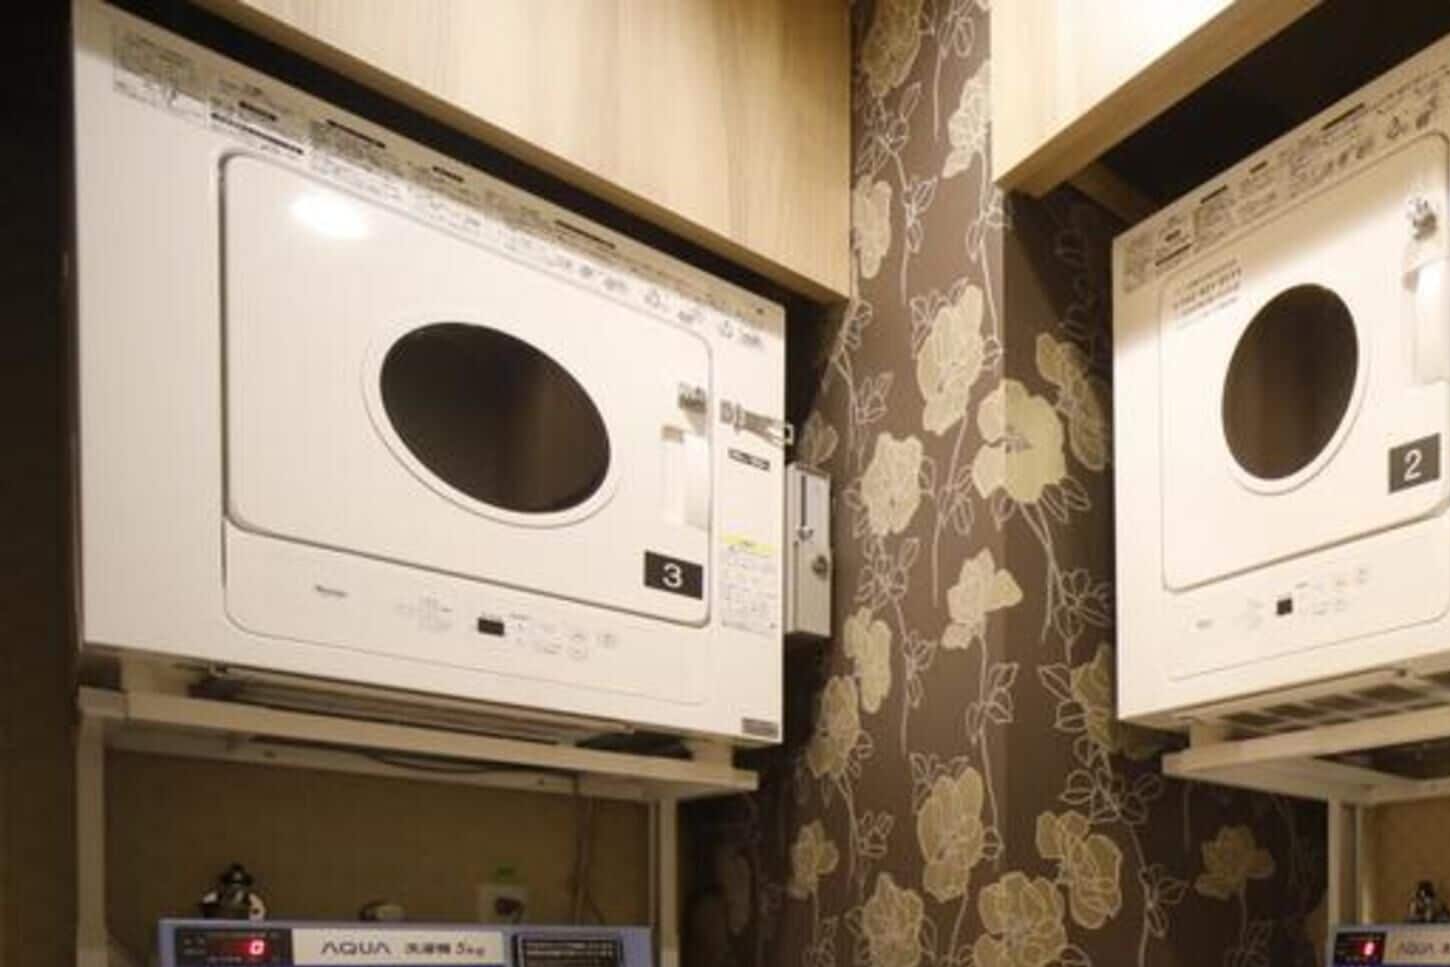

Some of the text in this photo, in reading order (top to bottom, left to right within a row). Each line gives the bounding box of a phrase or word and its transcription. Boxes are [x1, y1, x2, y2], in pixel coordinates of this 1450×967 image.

[1403, 449, 1422, 481] 2
[663, 562, 683, 588] 3
[249, 939, 265, 956] 0
[320, 940, 391, 956] AQUA
